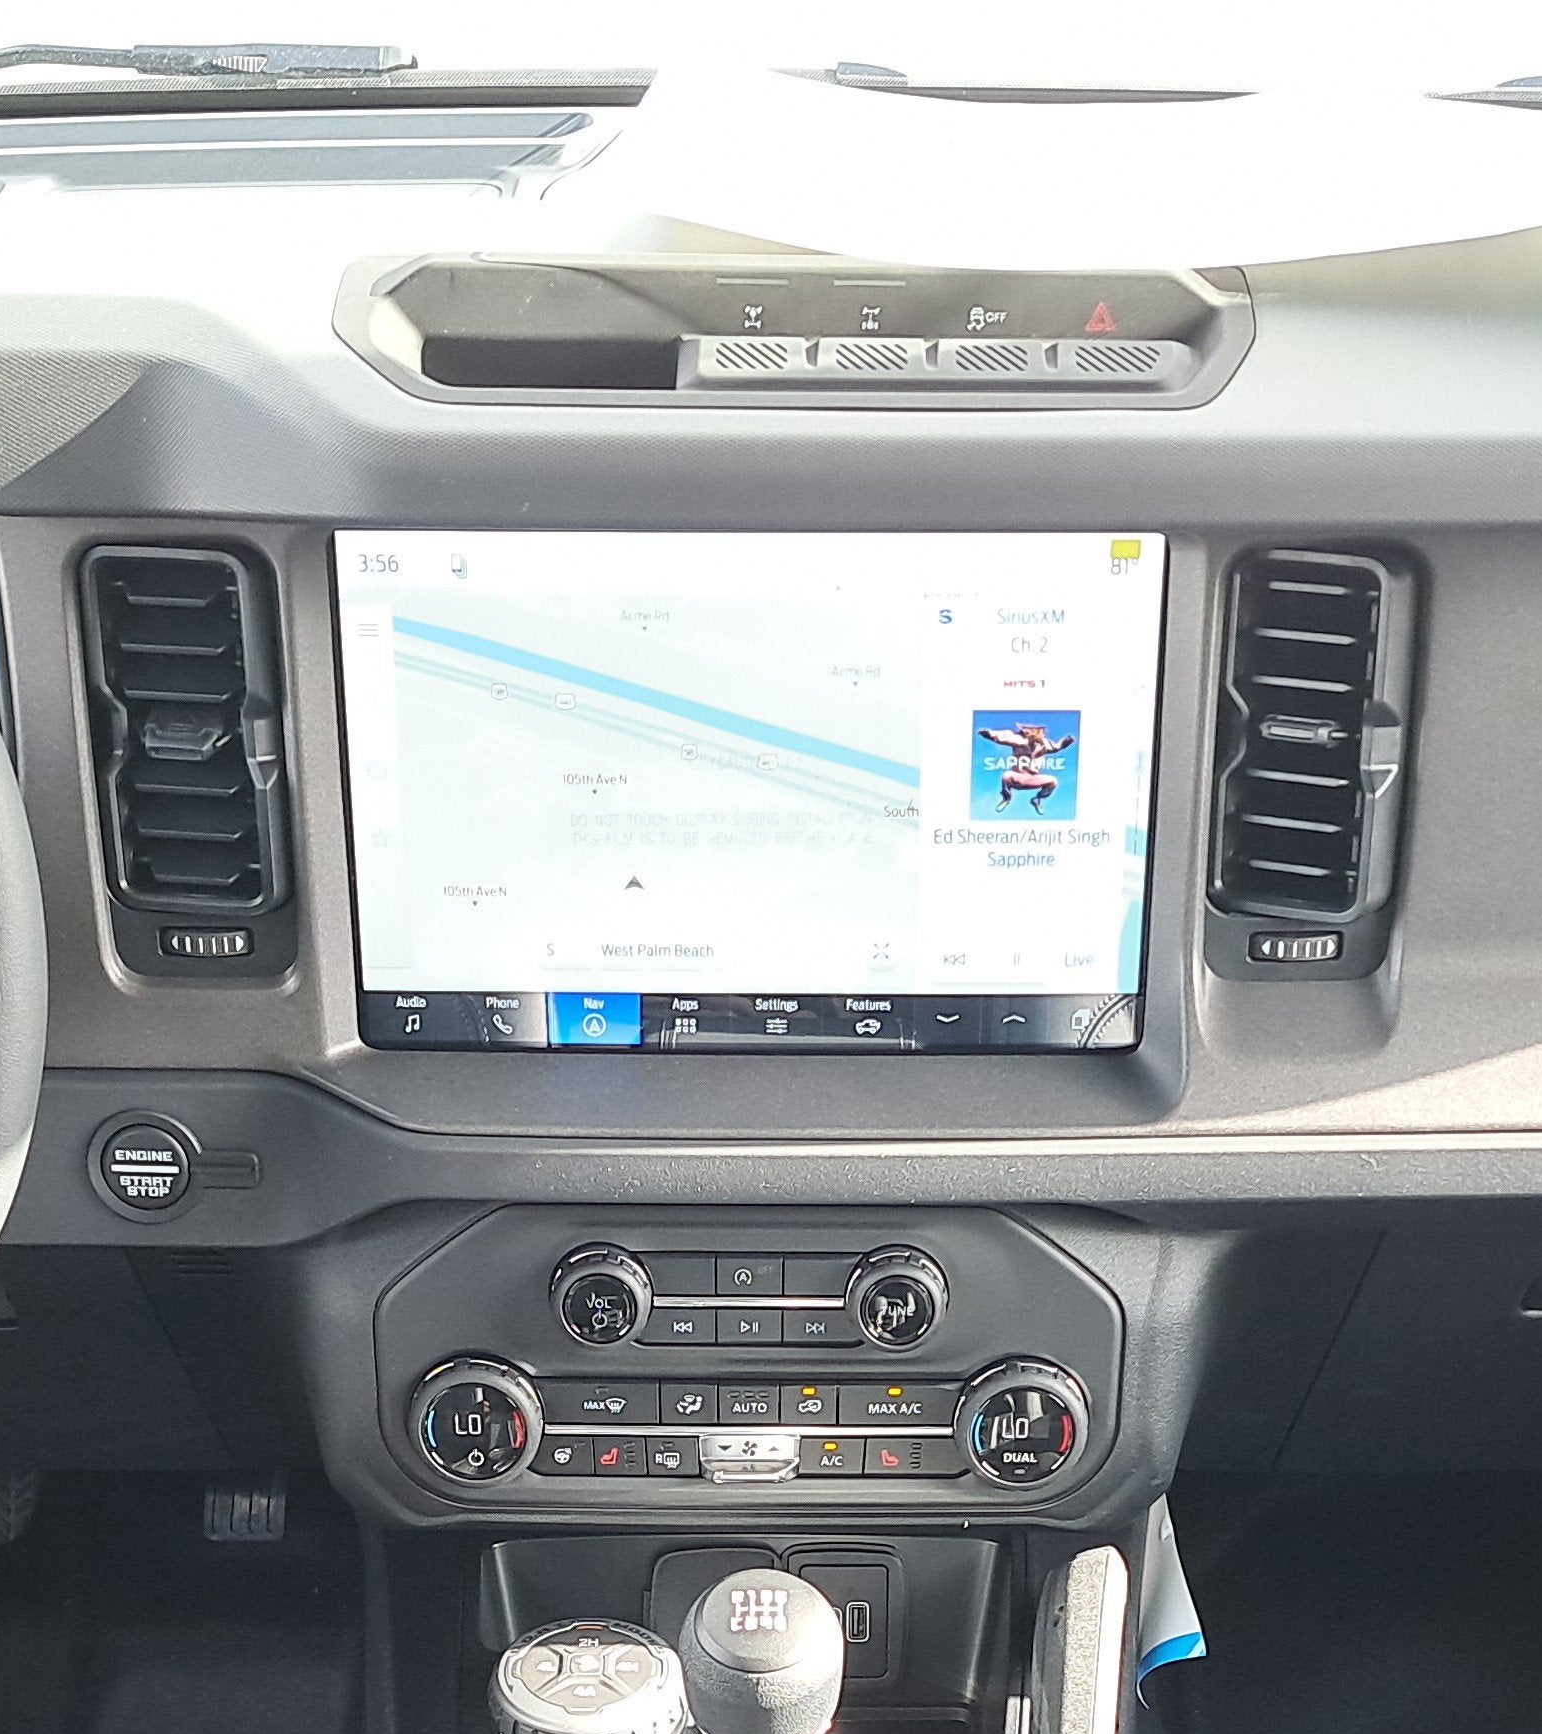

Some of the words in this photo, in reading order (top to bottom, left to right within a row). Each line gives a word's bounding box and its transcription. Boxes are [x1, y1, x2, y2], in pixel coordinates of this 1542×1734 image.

[985, 311, 1008, 324] OFF
[358, 554, 399, 573] 3:56
[997, 609, 1065, 625] SiriusXM
[1011, 637, 1035, 652] Ch.
[1039, 637, 1048, 652] 2
[1004, 680, 1036, 688] HITS
[1040, 680, 1046, 688] 1
[563, 774, 595, 785] 105th
[597, 774, 616, 785] Ave
[619, 774, 627, 785] N
[569, 814, 587, 827] DO
[595, 814, 619, 827] NOT
[683, 831, 699, 845] BE
[934, 829, 953, 845] Ed
[957, 829, 1062, 847] Sheeran/Arijit
[1067, 829, 1110, 847] Singh
[987, 851, 1055, 868] Sapphire
[443, 886, 474, 897] 105th
[476, 886, 496, 897] Ave
[499, 886, 507, 897] N
[546, 944, 555, 956] S
[601, 944, 635, 956] West
[637, 944, 672, 956] Palm
[674, 944, 715, 957] Beach
[1064, 953, 1094, 967] Live
[396, 995, 427, 1008] Audio
[485, 996, 520, 1009] Phone
[584, 998, 605, 1009] Nav
[672, 998, 699, 1012] Apps
[755, 998, 798, 1013] Settings
[846, 999, 891, 1012] Features
[114, 1150, 174, 1162] ENGINE
[119, 1175, 174, 1187] START
[126, 1186, 170, 1198] STOP
[587, 1293, 612, 1309] VOL
[583, 1401, 606, 1411] MAX
[732, 1402, 768, 1414] AUTO
[868, 1403, 897, 1415] MAX
[899, 1403, 923, 1415] A/C
[455, 1412, 482, 1436] LO
[820, 1455, 843, 1467] A/C
[1003, 1452, 1038, 1464] DUAL
[578, 1637, 599, 1648] 2H
